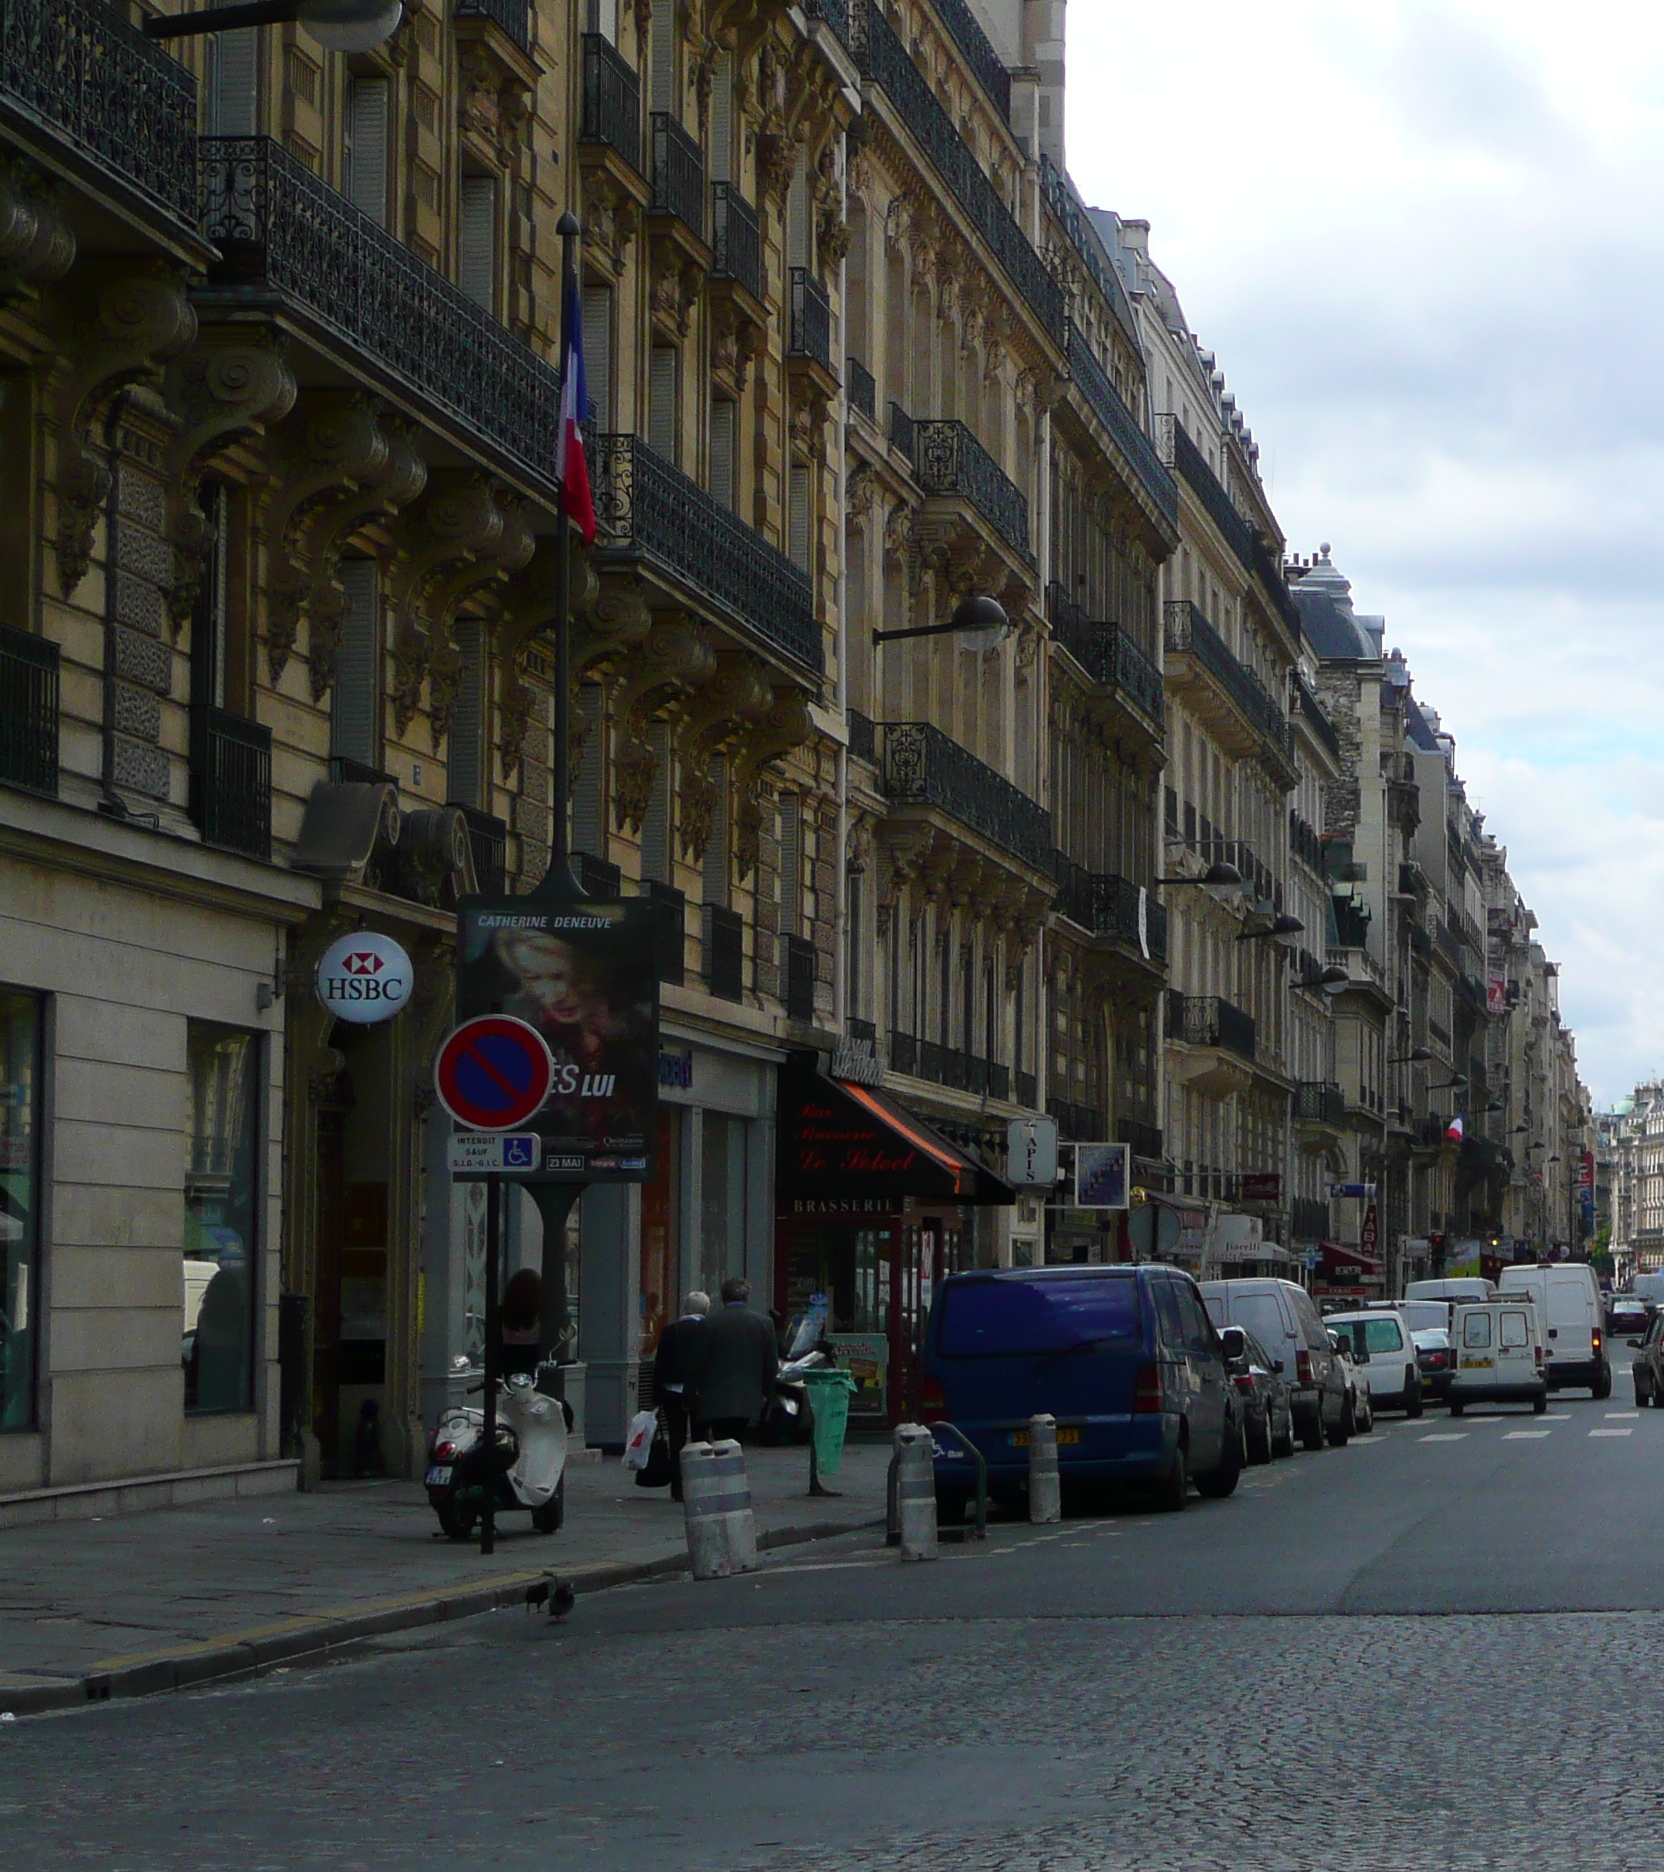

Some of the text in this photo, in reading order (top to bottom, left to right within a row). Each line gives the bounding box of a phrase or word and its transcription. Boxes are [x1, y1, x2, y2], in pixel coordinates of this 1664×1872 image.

[477, 916, 613, 929] CATHERINE DENEUVE
[327, 978, 402, 1001] HSBC
[581, 1073, 617, 1097] LUI
[456, 1137, 496, 1146] INTERDIT
[466, 1148, 489, 1157] SAUF
[550, 1158, 564, 1168] 23
[565, 1157, 583, 1168] MAI
[793, 1199, 895, 1213] BRASSERIE
